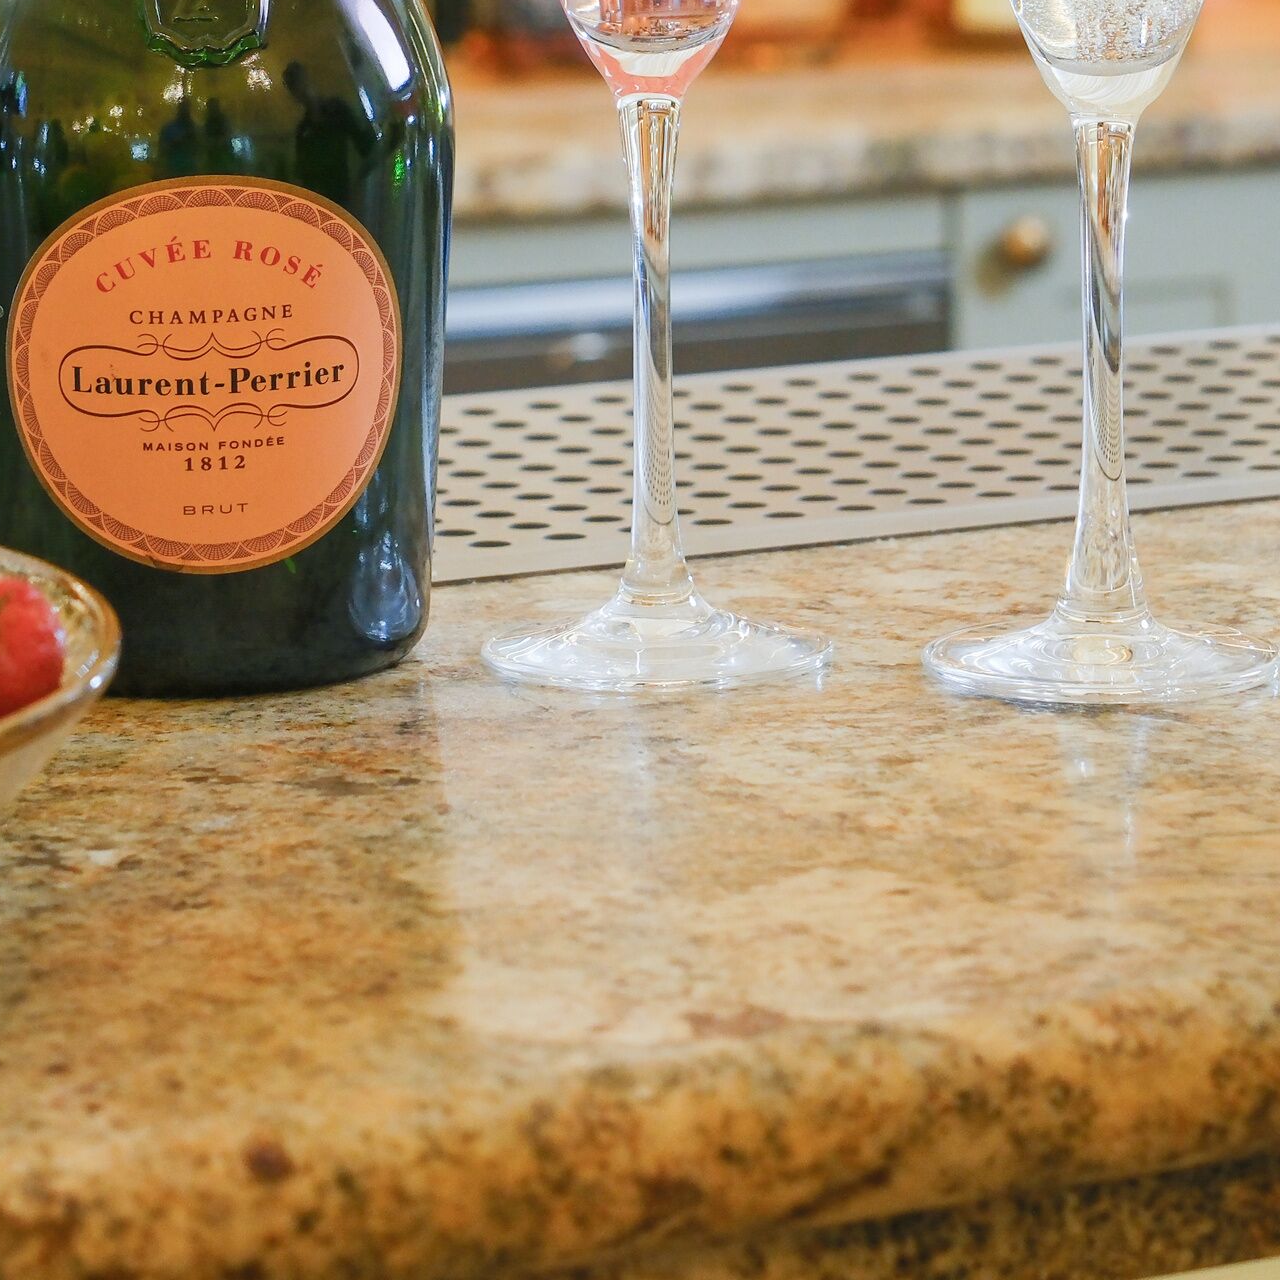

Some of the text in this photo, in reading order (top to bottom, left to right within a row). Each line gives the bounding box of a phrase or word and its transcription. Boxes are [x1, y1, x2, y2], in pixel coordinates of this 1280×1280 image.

[95, 236, 323, 295] CUVÉE ROSÉ
[129, 304, 294, 326] CHAMPAGNE
[72, 360, 346, 397] Laurent-Perrier
[142, 436, 286, 453] MAISON FONDÉE
[183, 454, 248, 473] 1812
[182, 502, 250, 517] BRUT
